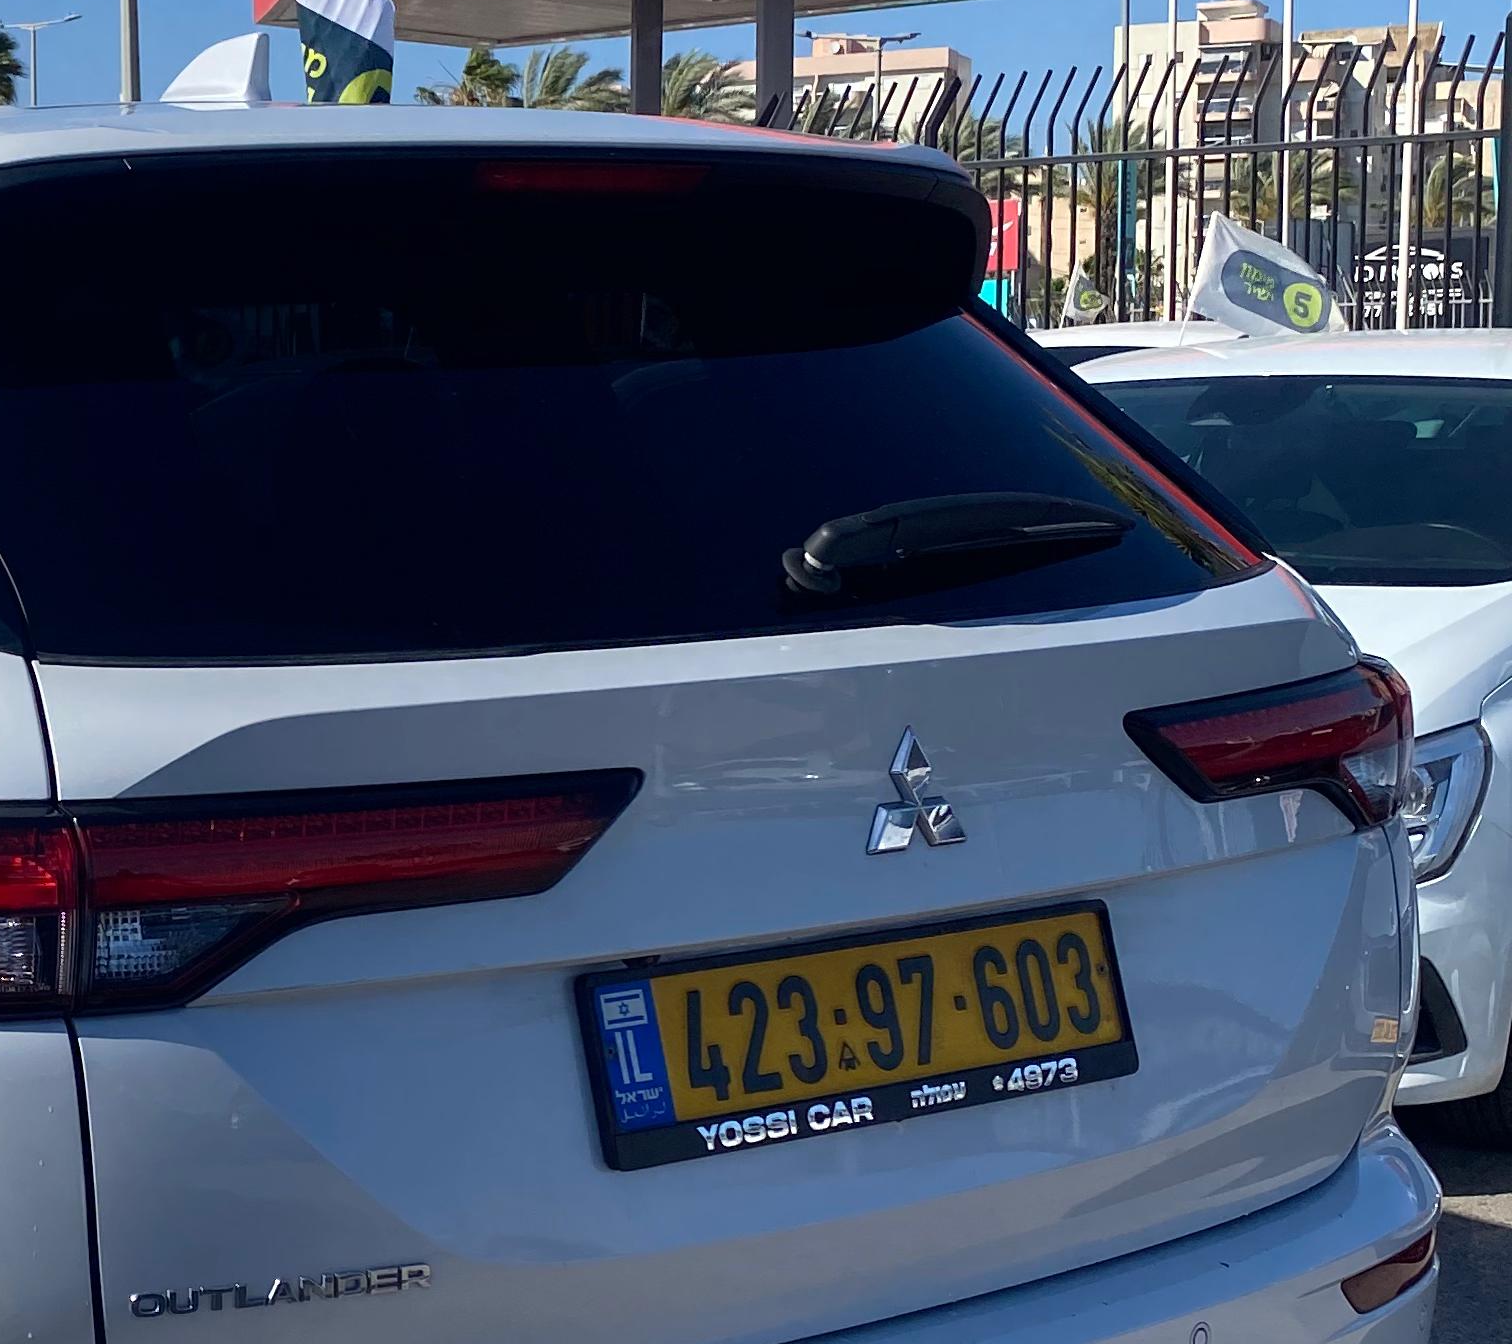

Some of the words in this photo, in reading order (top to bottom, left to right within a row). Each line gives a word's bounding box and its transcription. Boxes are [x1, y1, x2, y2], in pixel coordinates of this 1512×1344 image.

[1294, 290, 1313, 319] 5
[614, 1029, 653, 1085] IL
[615, 1086, 664, 1105] ישראל
[696, 1109, 799, 1151] YOSSI
[807, 1096, 875, 1131] CAR
[128, 1261, 433, 1319] OUTLANDER
